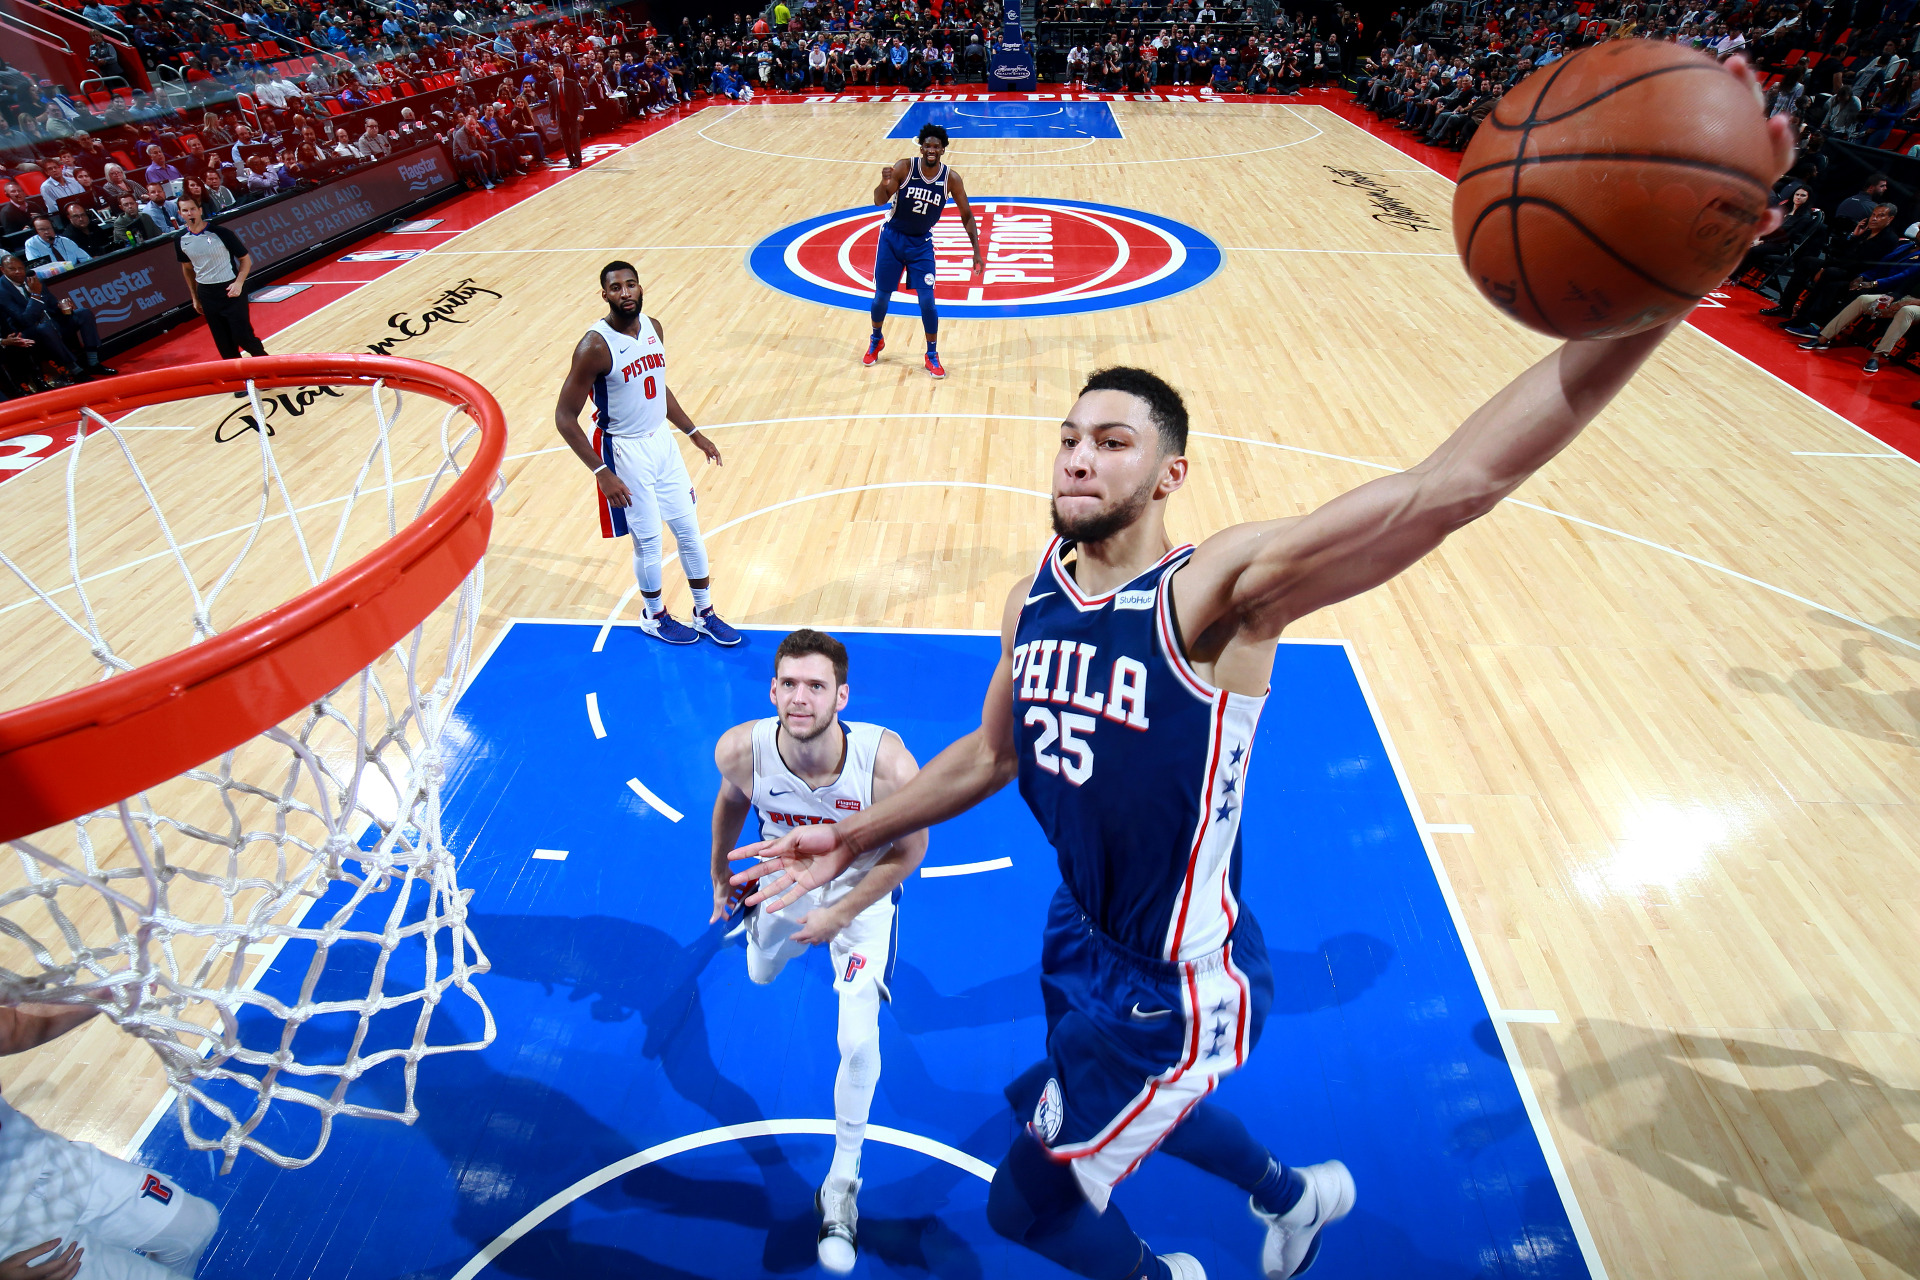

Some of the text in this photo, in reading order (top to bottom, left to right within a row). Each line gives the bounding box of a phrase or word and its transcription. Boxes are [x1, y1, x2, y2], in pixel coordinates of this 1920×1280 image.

[803, 93, 1225, 103] DETROIT PISTONS
[398, 157, 437, 182] Flagstar
[905, 186, 941, 207] PHILA
[912, 200, 928, 215] 21
[235, 184, 362, 244] FICIAL BANK AND
[250, 200, 375, 264] RTGAGE PARTNER
[983, 214, 1055, 285] PISTONS
[68, 267, 153, 311] Flagstar
[135, 290, 166, 311] Bank
[387, 277, 503, 340] Equity
[621, 352, 666, 384] PISTONS
[643, 375, 657, 400] 0
[1119, 595, 1152, 604] StubHub
[1012, 639, 1150, 732] PHILA
[1023, 705, 1096, 787] 25
[766, 810, 838, 827] PIST
